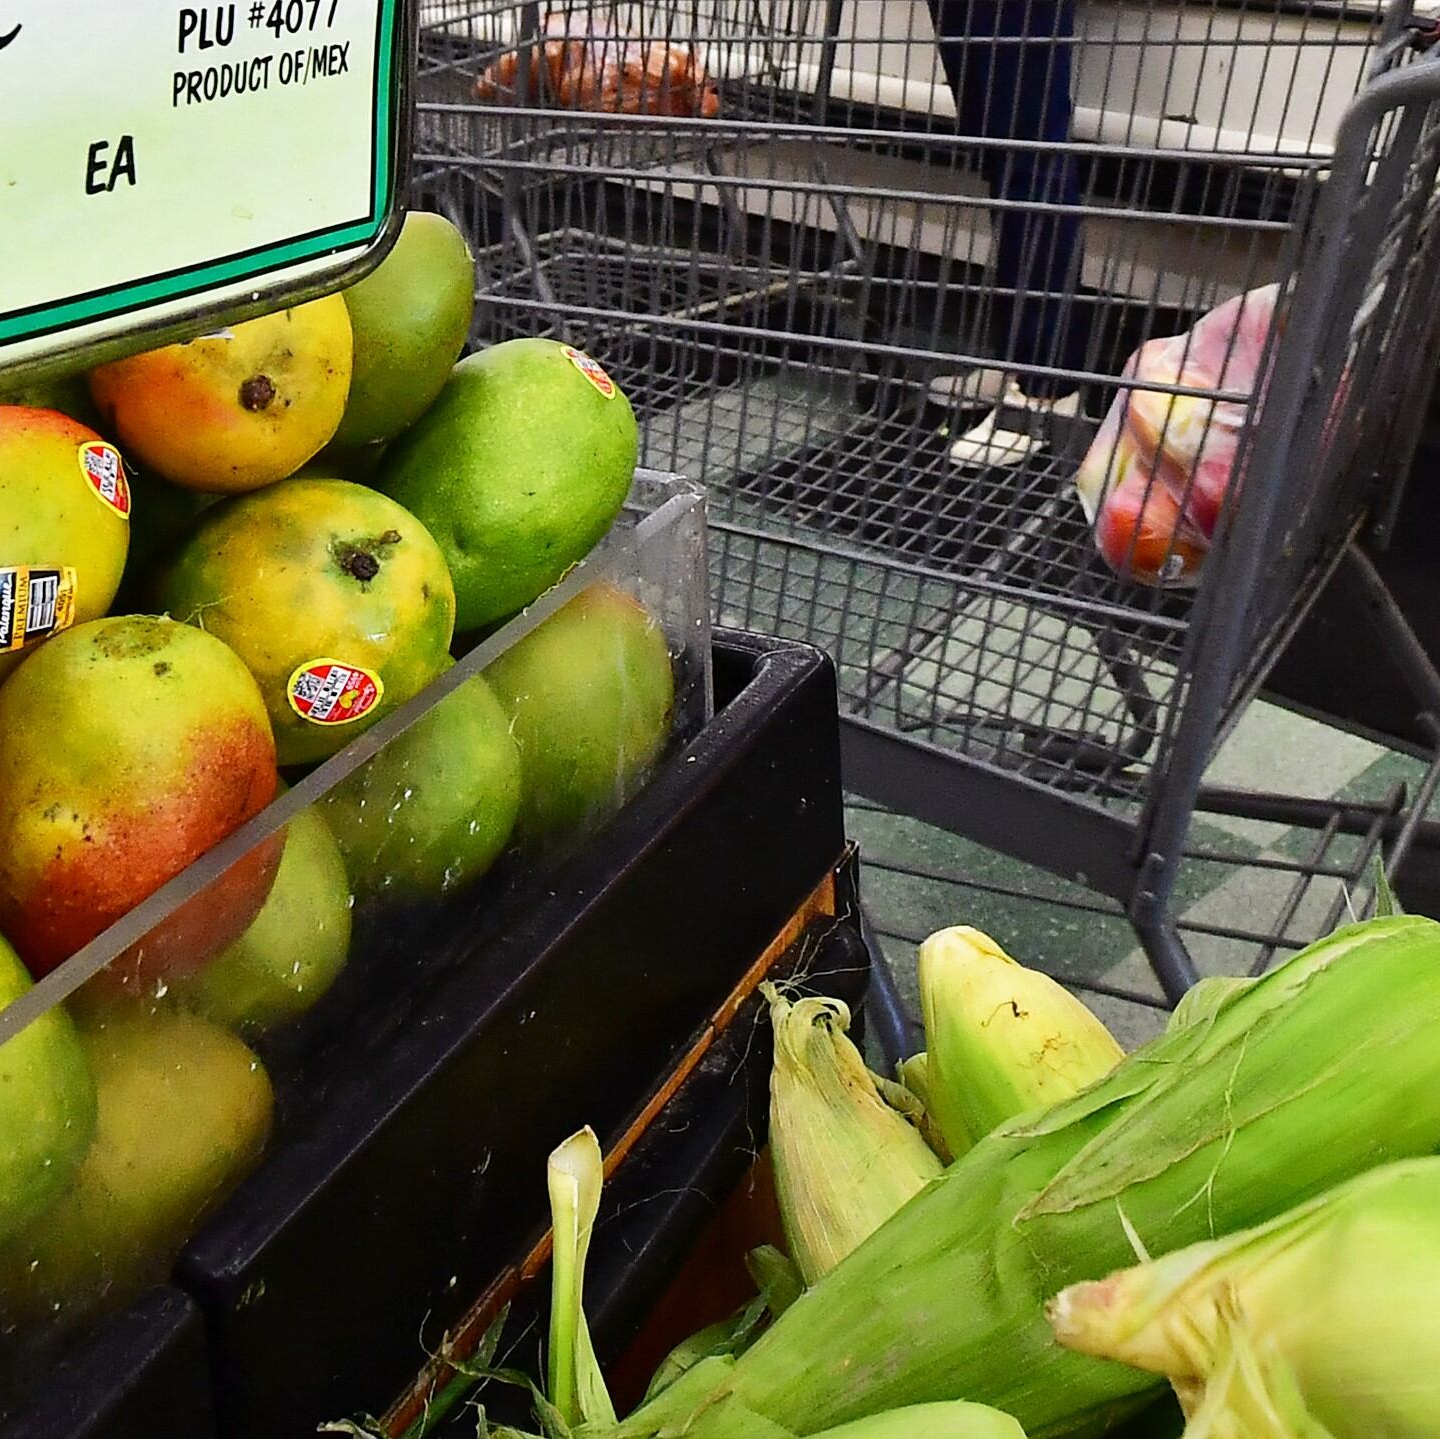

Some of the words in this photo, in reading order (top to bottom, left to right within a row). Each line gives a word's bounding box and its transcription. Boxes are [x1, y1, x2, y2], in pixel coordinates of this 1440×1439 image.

[176, 5, 236, 54] PLU
[171, 53, 273, 107] PRODUCT
[277, 40, 351, 88] OF/MEX
[84, 134, 137, 195] EA
[14, 575, 29, 640] PREMIUM
